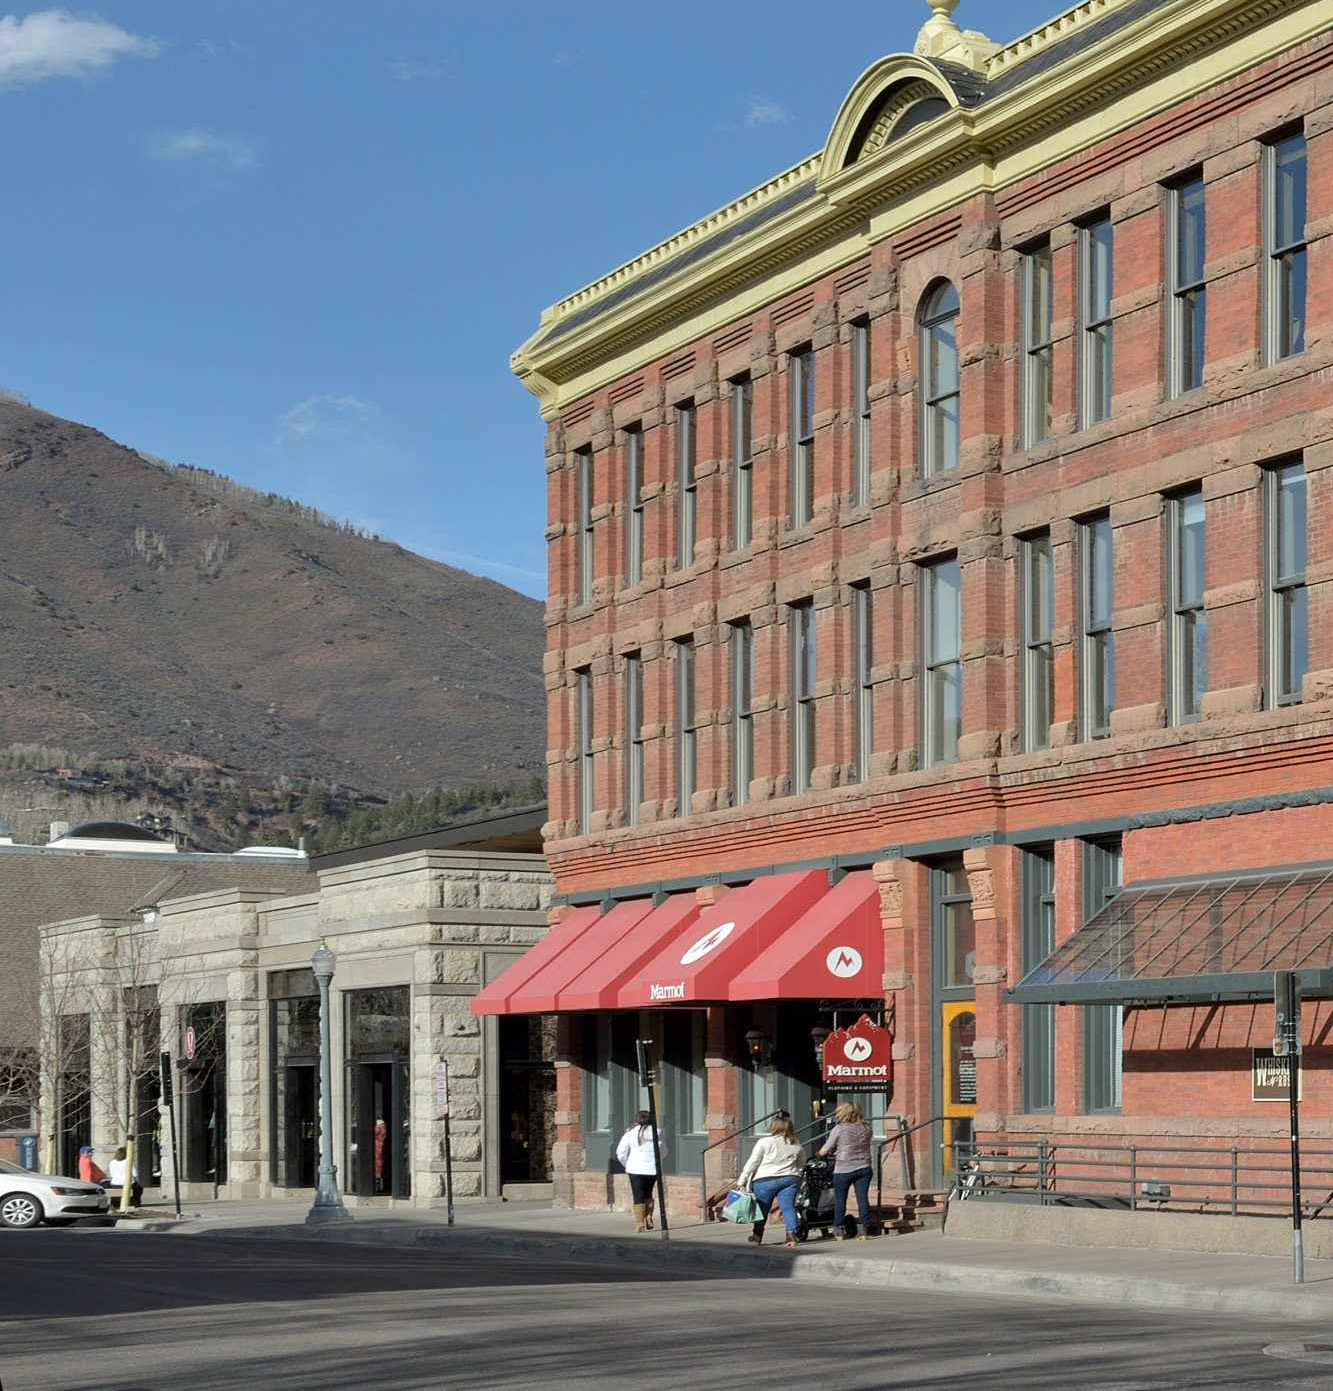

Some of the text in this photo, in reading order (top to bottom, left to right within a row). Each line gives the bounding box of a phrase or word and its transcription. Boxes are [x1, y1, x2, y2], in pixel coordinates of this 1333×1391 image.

[650, 981, 685, 1000] Marmot
[827, 1064, 888, 1076] Marmot
[1256, 1057, 1290, 1087] WHISK
